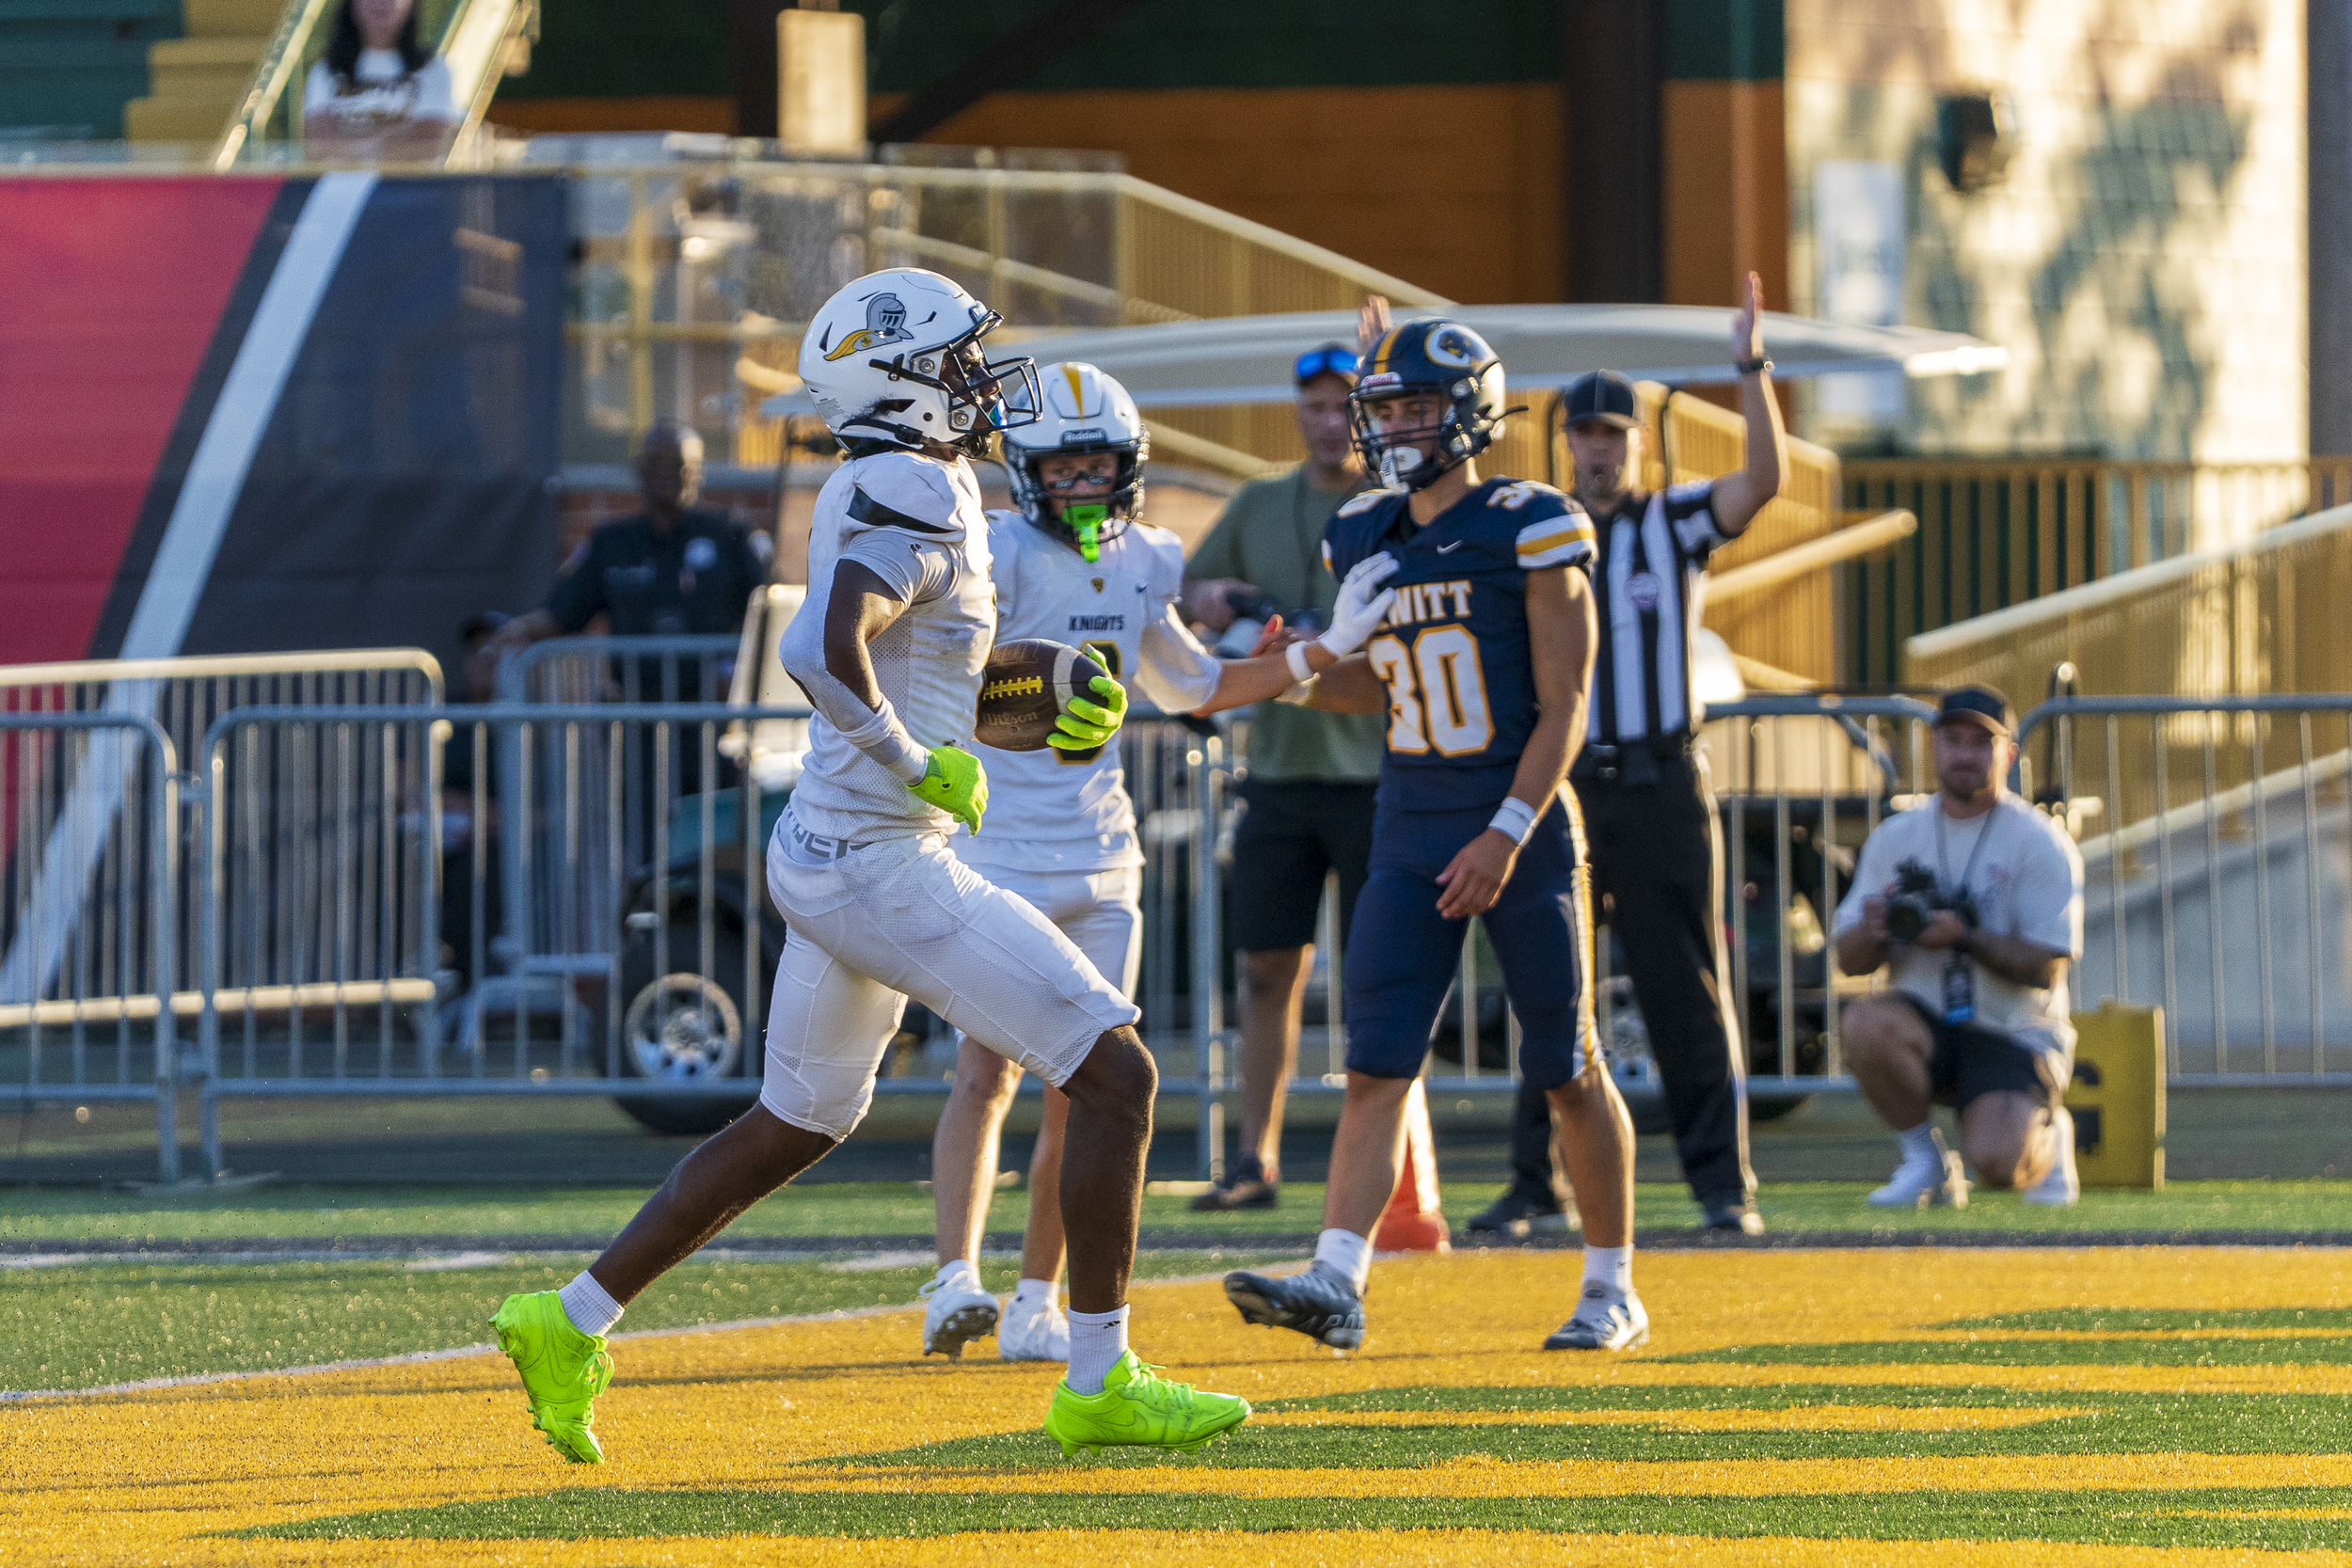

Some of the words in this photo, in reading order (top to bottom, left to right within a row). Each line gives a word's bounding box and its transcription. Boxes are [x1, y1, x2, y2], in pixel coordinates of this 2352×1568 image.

[1068, 613, 1125, 632] KNIGHTS
[1379, 578, 1473, 631] WITT
[1367, 622, 1497, 759] 30
[982, 710, 1039, 726] Wilson
